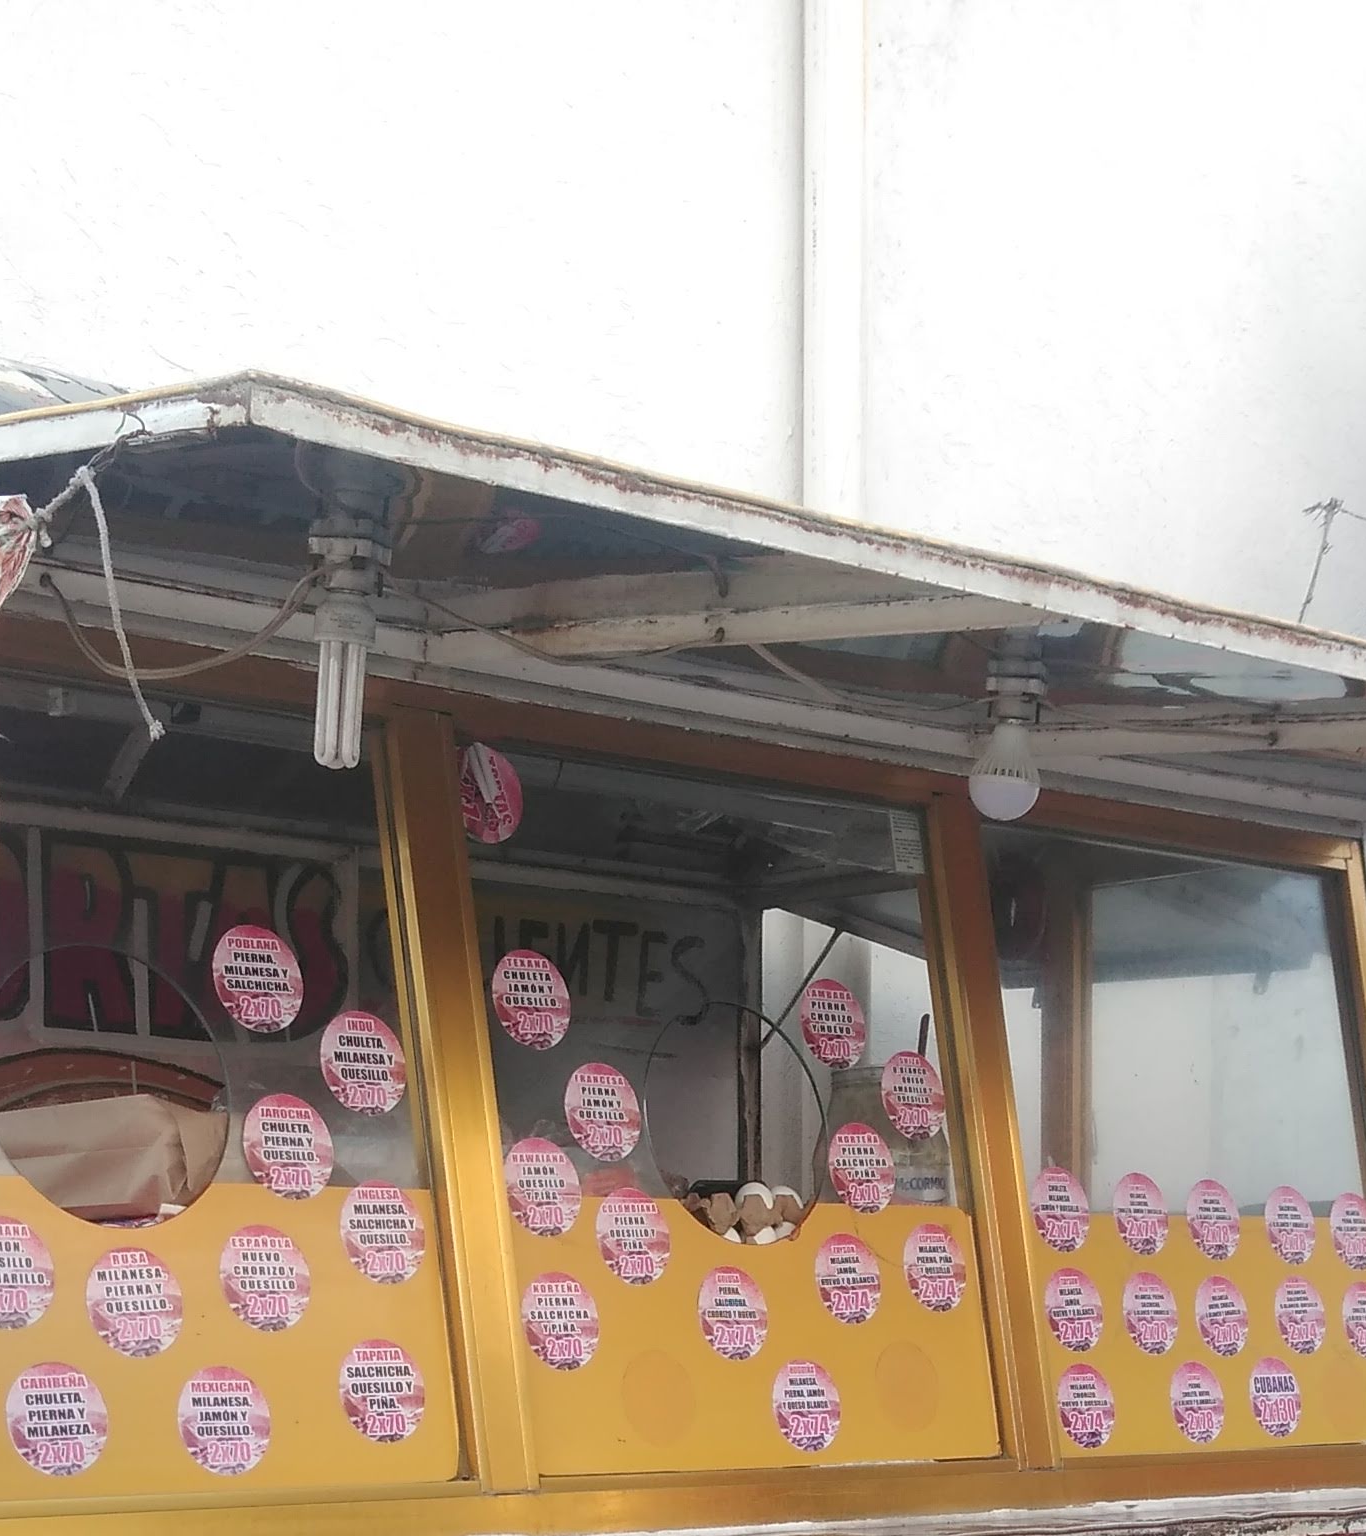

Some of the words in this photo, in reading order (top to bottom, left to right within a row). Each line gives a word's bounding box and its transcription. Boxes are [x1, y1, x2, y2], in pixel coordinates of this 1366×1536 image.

[19, 1374, 87, 1389] CARIBEÑA
[1253, 1375, 1295, 1393] CUBANAS
[27, 1408, 76, 1422] PIERNA
[26, 1423, 95, 1438] MILANEZA.
[38, 1440, 86, 1466] 2x70
